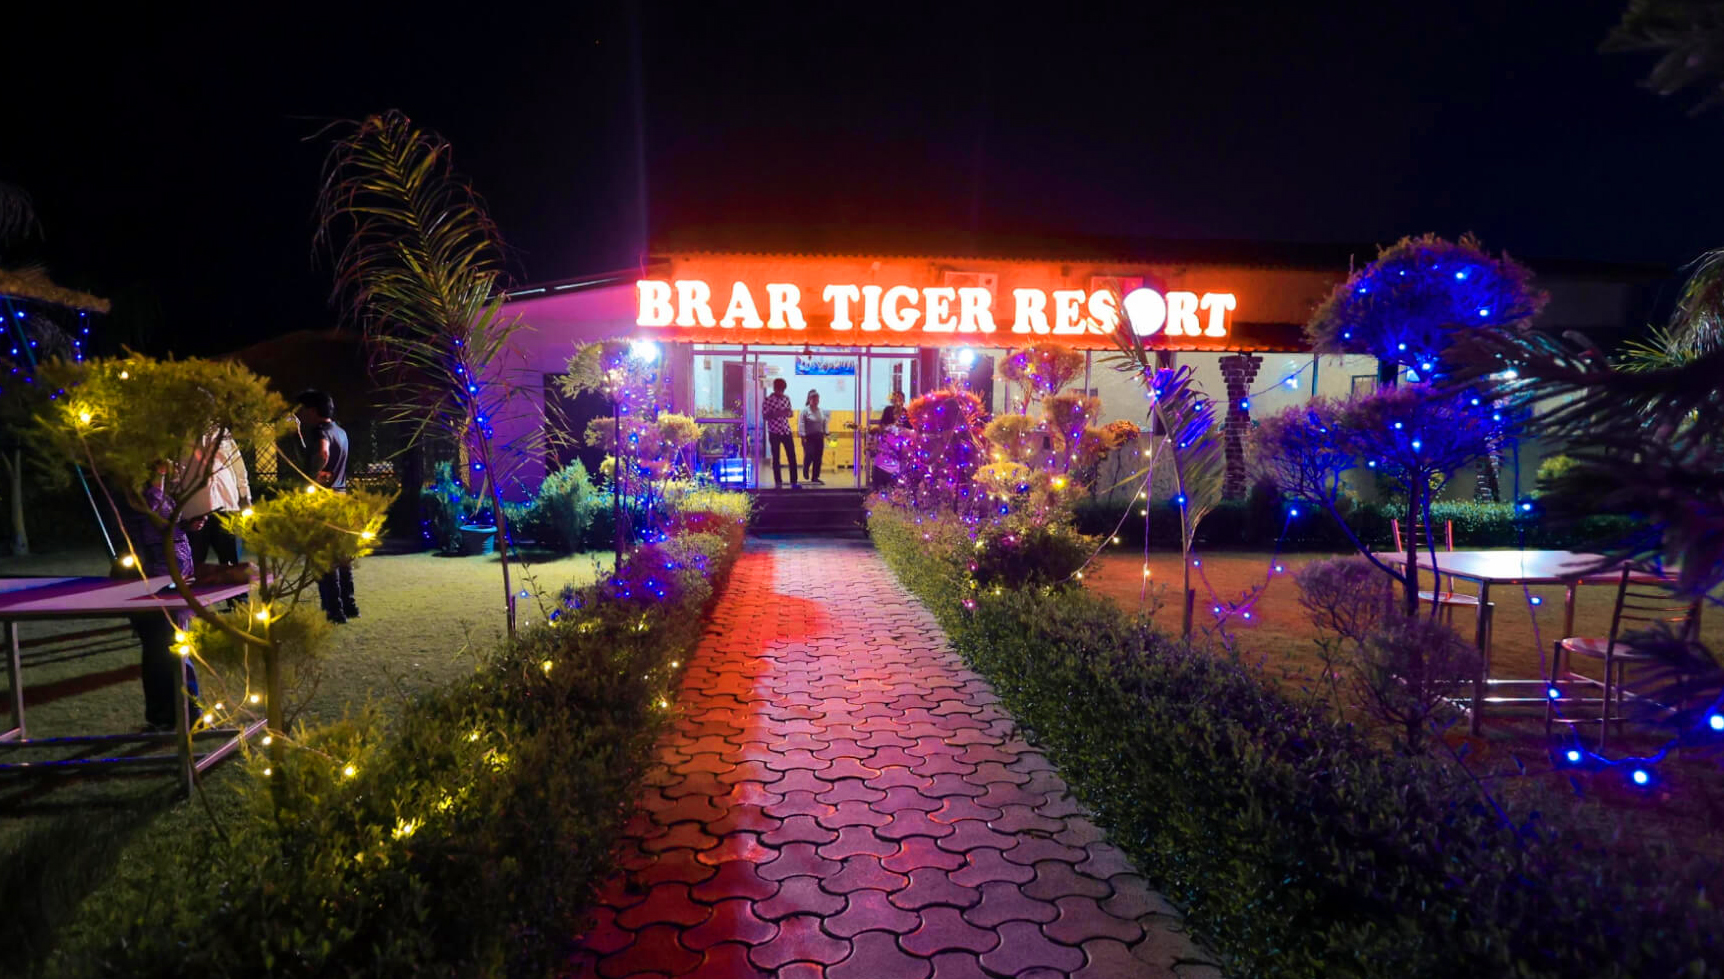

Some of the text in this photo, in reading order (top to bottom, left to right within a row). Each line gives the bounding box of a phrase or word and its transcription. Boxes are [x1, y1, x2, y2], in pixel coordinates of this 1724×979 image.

[635, 279, 1237, 337] BRAR TIGER RESORT
